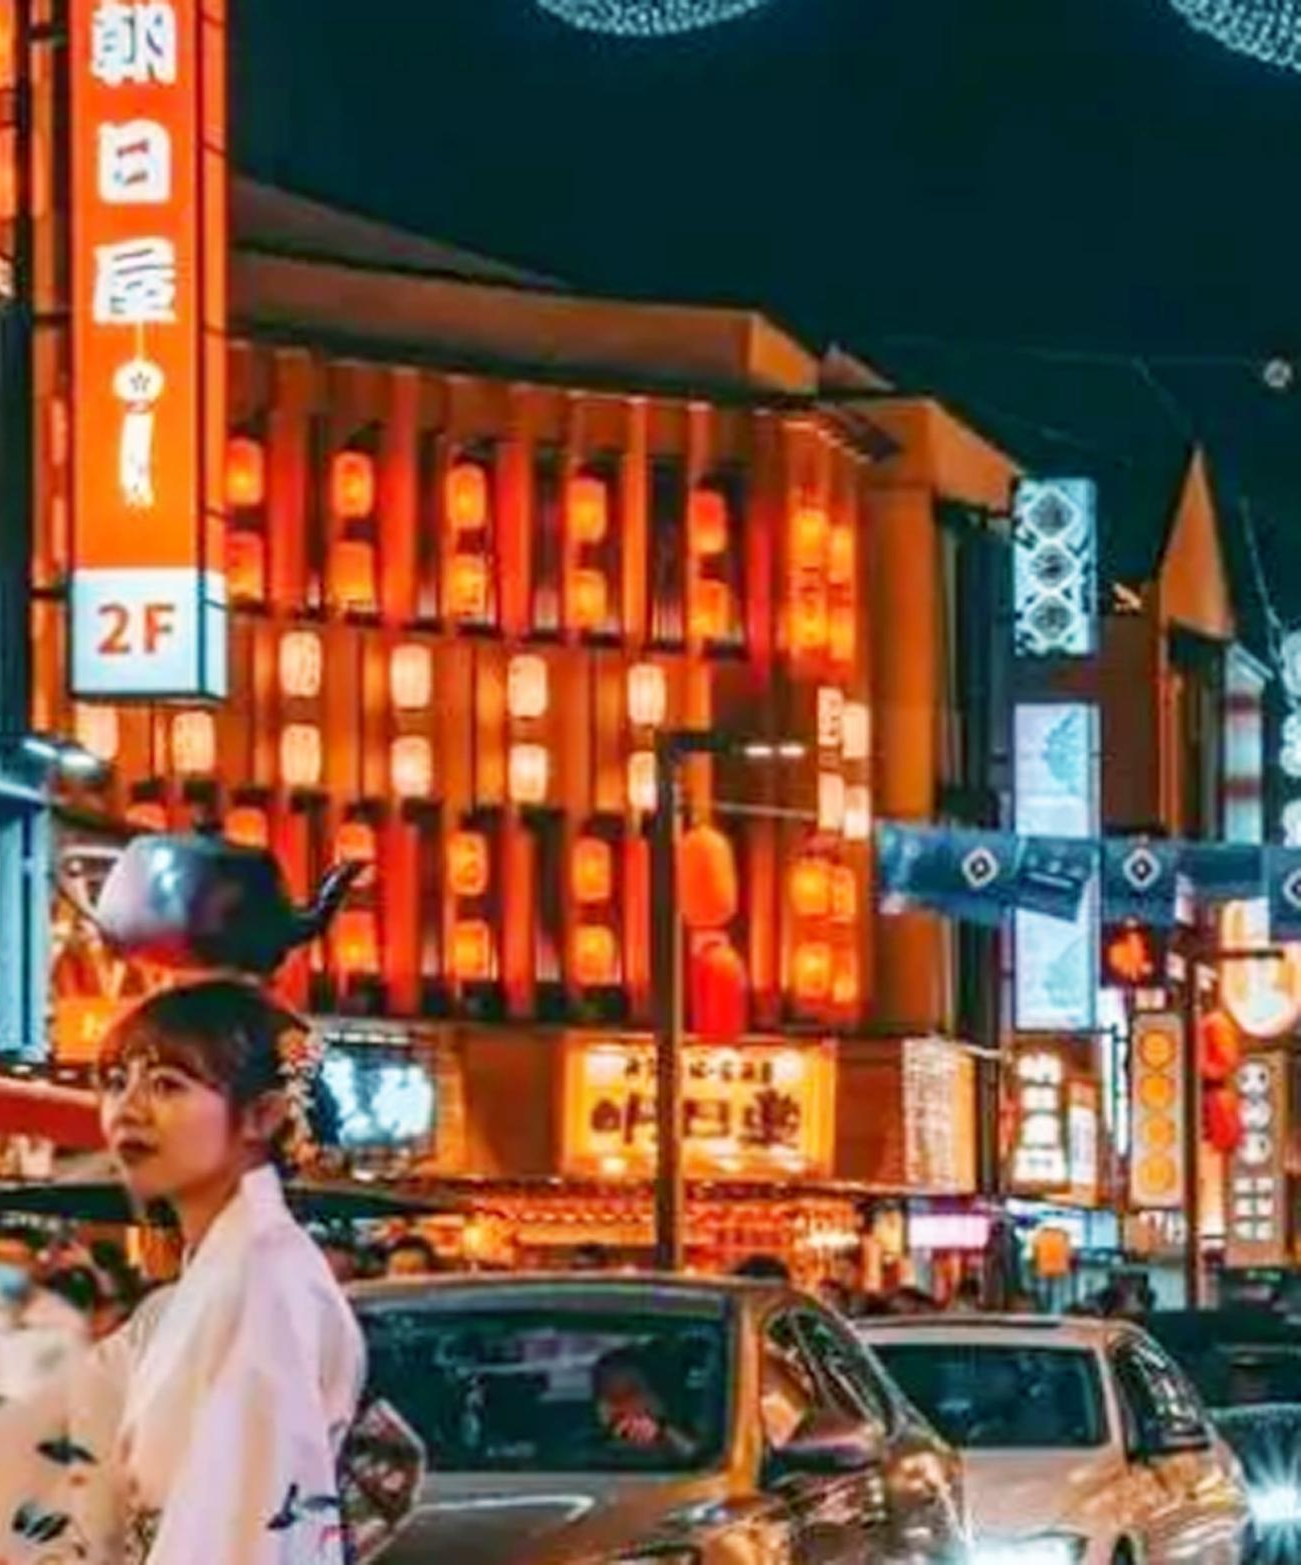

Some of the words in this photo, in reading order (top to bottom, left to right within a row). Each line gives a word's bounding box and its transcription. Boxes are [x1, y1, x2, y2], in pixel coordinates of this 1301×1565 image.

[91, 2, 178, 324] 朝日屋
[98, 602, 175, 655] 2F
